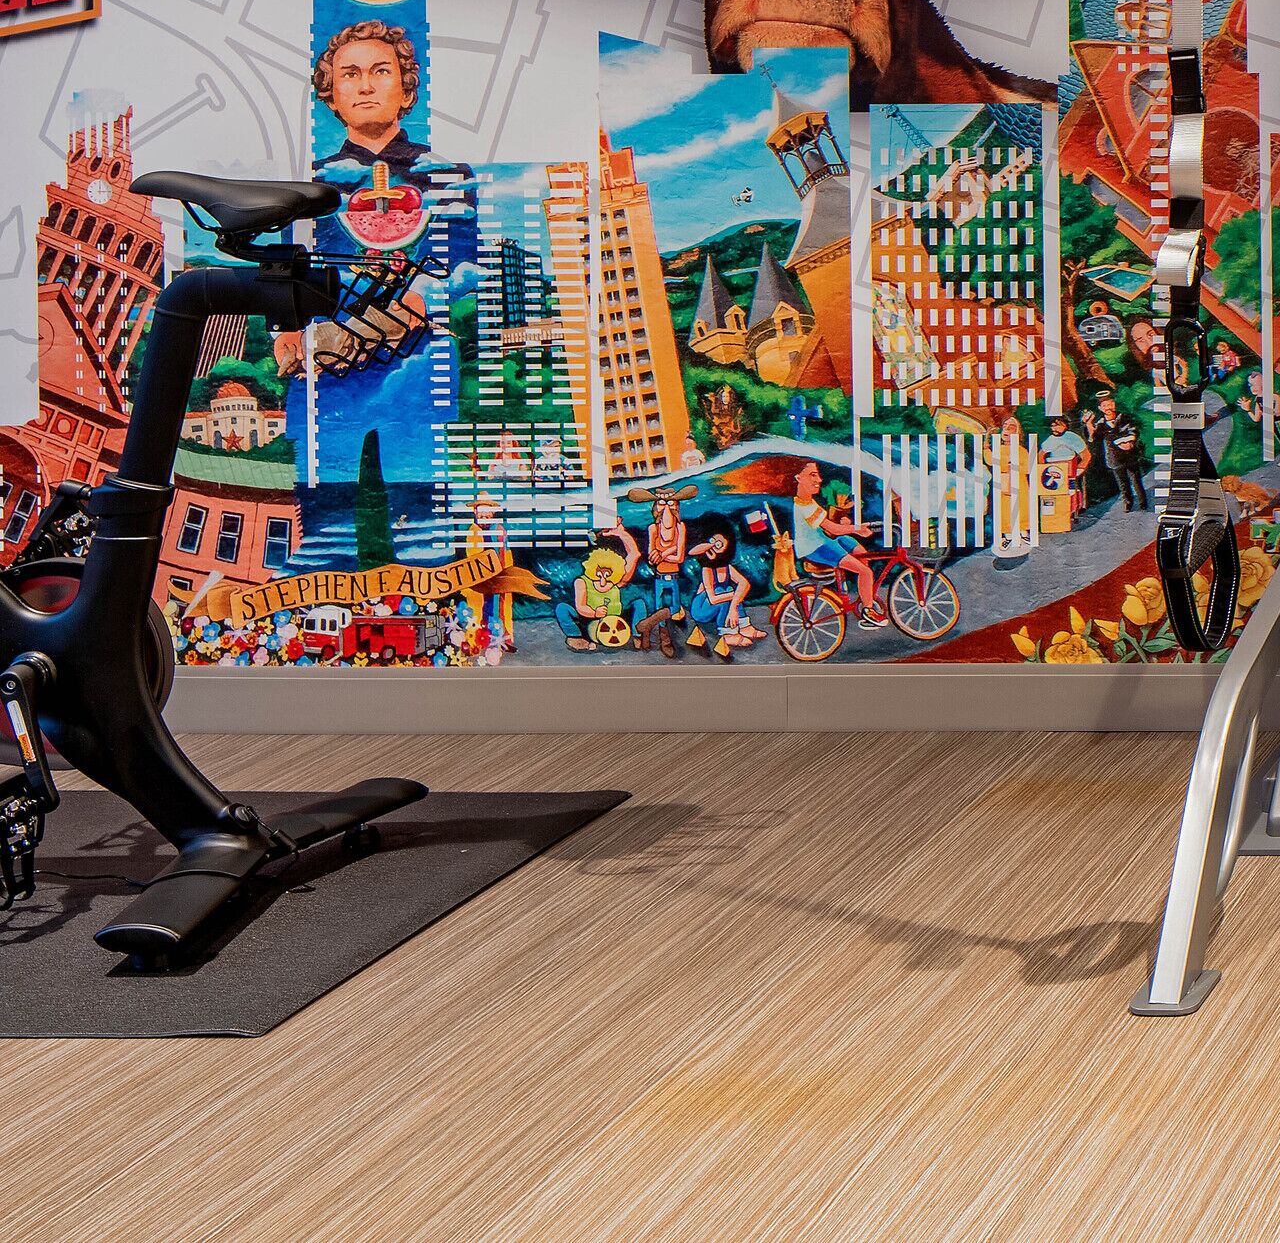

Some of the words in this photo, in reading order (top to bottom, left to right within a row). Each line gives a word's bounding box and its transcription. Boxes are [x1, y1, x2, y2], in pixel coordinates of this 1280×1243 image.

[241, 574, 369, 621] STEPHEN
[378, 569, 391, 594] F.
[397, 554, 496, 598] AUSTIN
